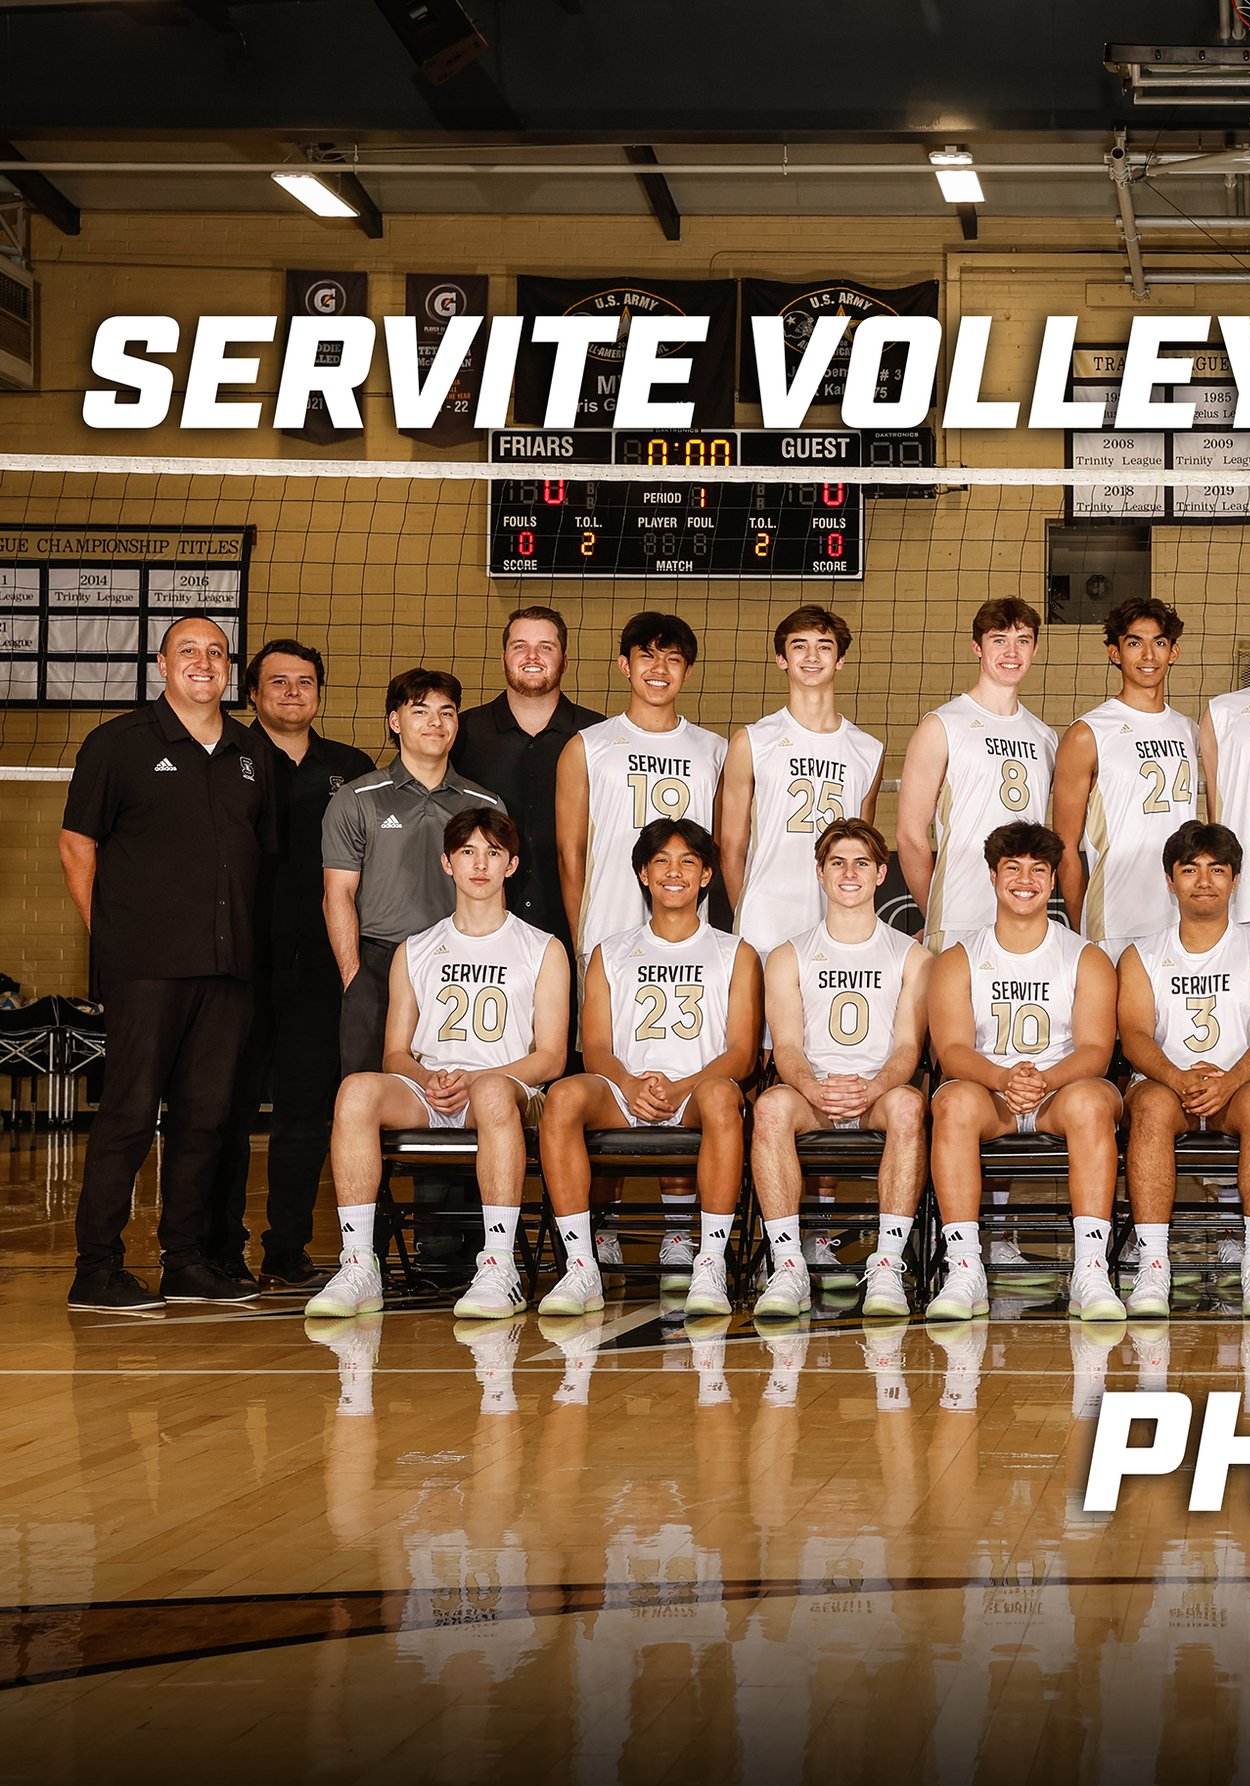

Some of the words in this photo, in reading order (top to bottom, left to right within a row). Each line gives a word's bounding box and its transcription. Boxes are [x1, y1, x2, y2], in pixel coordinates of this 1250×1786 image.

[595, 295, 620, 309] U.S.
[623, 293, 659, 311] ARMY
[809, 294, 834, 309] U.S.
[838, 292, 873, 311] ARMY
[1204, 392, 1232, 402] 1985
[500, 436, 574, 456] FRIARS
[781, 437, 850, 458] GUEST
[1103, 439, 1135, 449] 2008
[1203, 439, 1234, 449] 2009
[1076, 456, 1115, 467] Trinity
[1122, 456, 1162, 467] League
[1176, 456, 1213, 467] Trinity
[643, 493, 682, 504] PERIOD
[700, 488, 706, 508] 1
[1104, 486, 1134, 496] 2018
[1204, 486, 1234, 496] 2019
[503, 516, 537, 527] FOULS
[575, 516, 602, 528] T.O.L.
[637, 517, 678, 528] PLAYER
[687, 517, 714, 528] FOUL
[749, 518, 777, 528] T.O.L.
[812, 518, 846, 529] FOULS
[37, 539, 170, 554] CHAMPIONSHIP
[178, 540, 239, 554] TITLES
[581, 531, 595, 555] 2
[755, 533, 769, 557] 2
[503, 559, 537, 571] SCORE
[656, 560, 693, 572] MATCH
[812, 561, 847, 572] SCORE
[80, 575, 108, 586] 2014
[180, 576, 209, 587] 2016
[985, 737, 1038, 761] SERVITE
[1135, 740, 1187, 759] SERVITE
[628, 754, 691, 777] SERVITE
[789, 758, 847, 783] SERVITE
[1000, 759, 1030, 812] 8
[1139, 760, 1192, 814] 24
[627, 774, 691, 829] 19
[787, 778, 844, 834] 25
[441, 963, 508, 984] SERVITE
[638, 965, 704, 983] SERVITE
[818, 970, 882, 989] SERVITE
[991, 981, 1050, 1001] SERVITE
[1171, 973, 1231, 995] SERVITE
[435, 984, 508, 1043] 20
[634, 984, 705, 1042] 23
[828, 990, 870, 1046] 0
[991, 1002, 1051, 1056] 10
[1183, 995, 1221, 1053] 3
